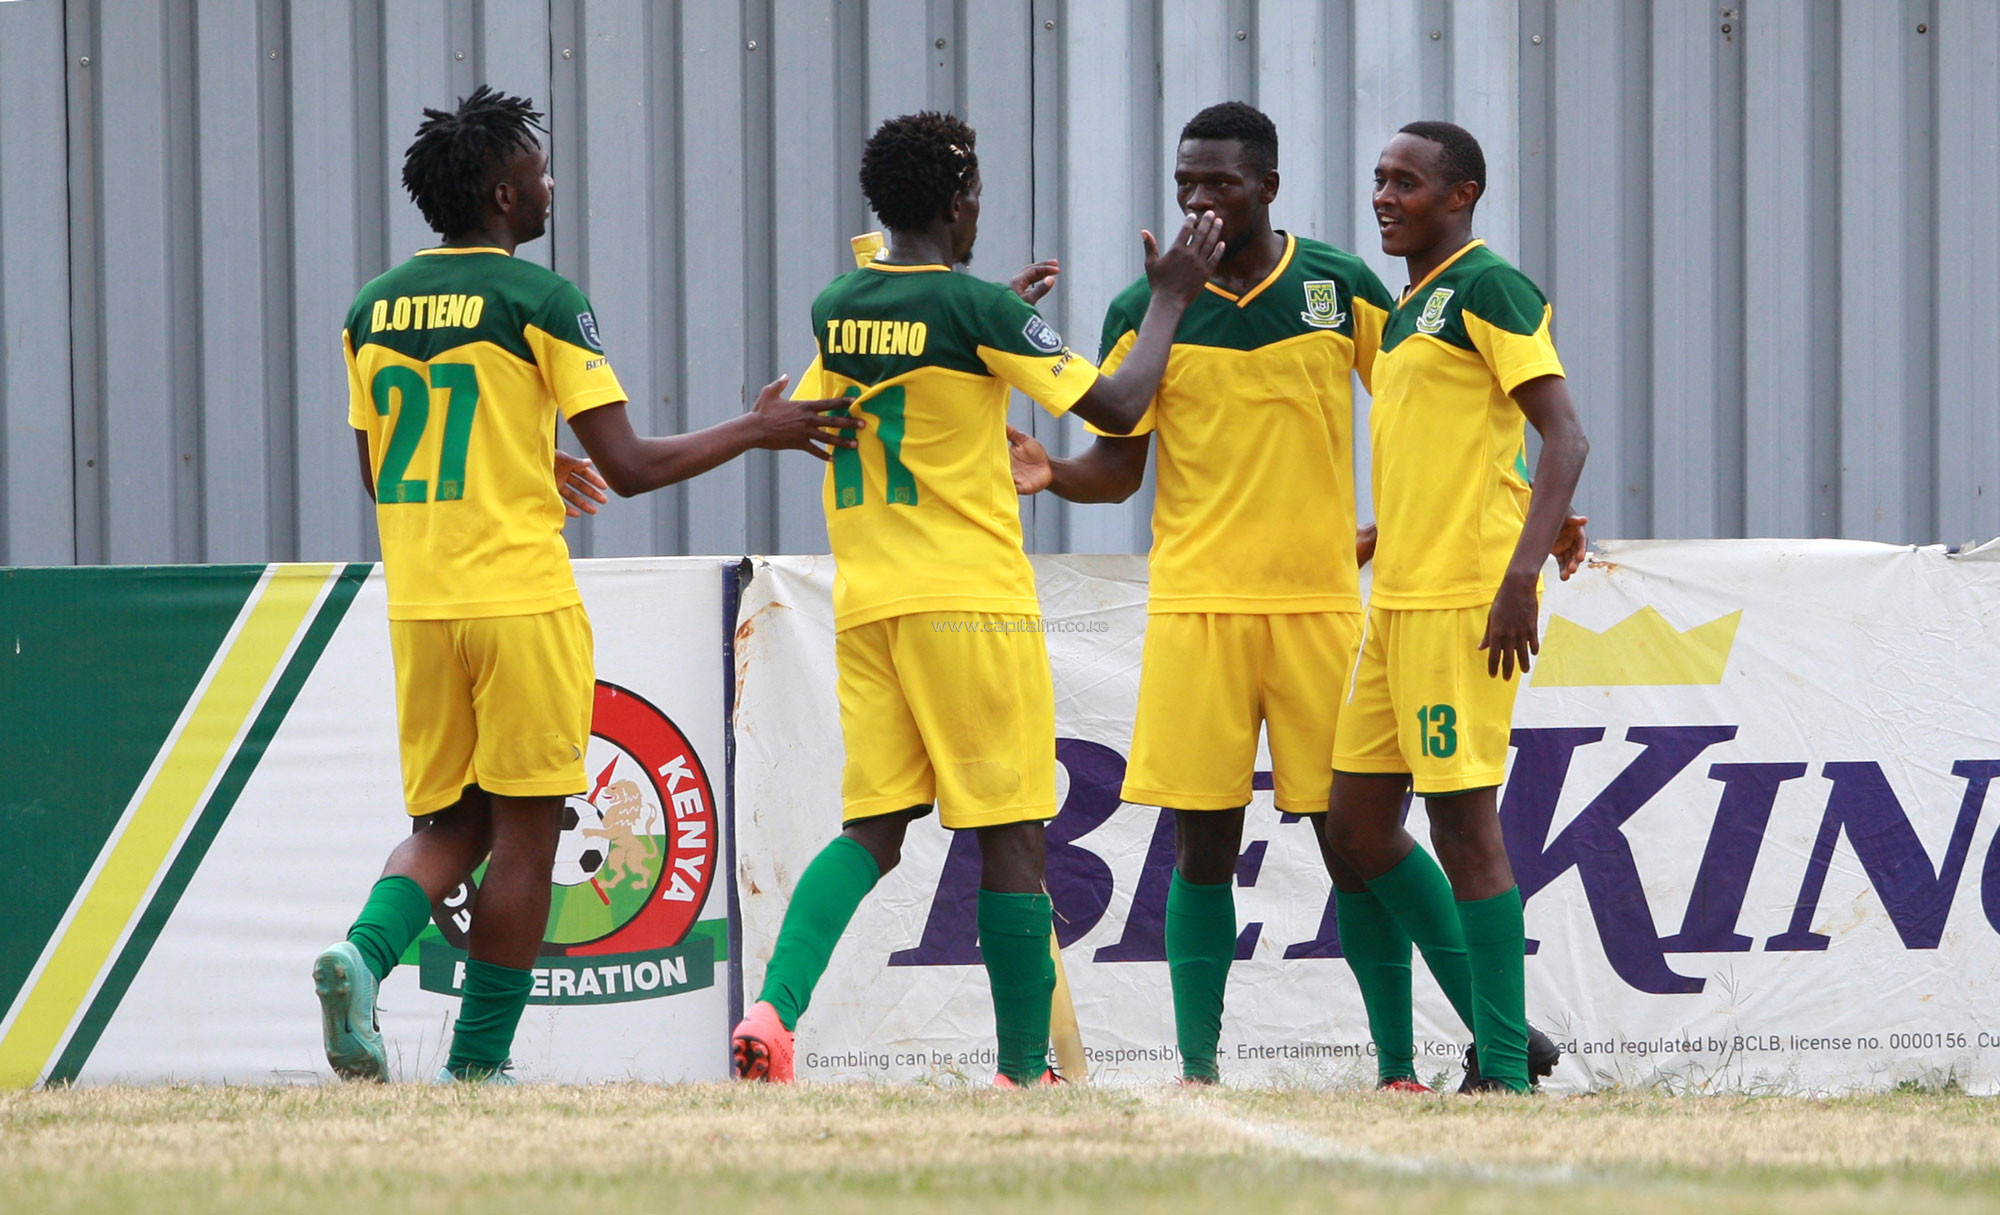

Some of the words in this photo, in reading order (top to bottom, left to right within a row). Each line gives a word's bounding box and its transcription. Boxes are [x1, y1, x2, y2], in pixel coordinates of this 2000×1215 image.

[371, 294, 484, 333] D.OTIENO
[827, 319, 926, 357] T.OTIENO
[371, 362, 480, 505] 27
[828, 385, 918, 509] 11
[1417, 704, 1458, 758] 13
[657, 754, 707, 903] KENYA
[452, 956, 688, 997] FERATION
[806, 1050, 889, 1070] Gambling
[895, 1053, 927, 1067] can
[931, 1049, 954, 1065] be
[1237, 1041, 1361, 1060] Entertainment
[1583, 1038, 1614, 1055] and
[1620, 1036, 1702, 1057] regulated
[1708, 1036, 1728, 1056] by
[1733, 1035, 1785, 1054] BCLB,
[1789, 1034, 1852, 1052] license
[1857, 1038, 1883, 1051] no.
[1889, 1032, 1971, 1050] 0000156.
